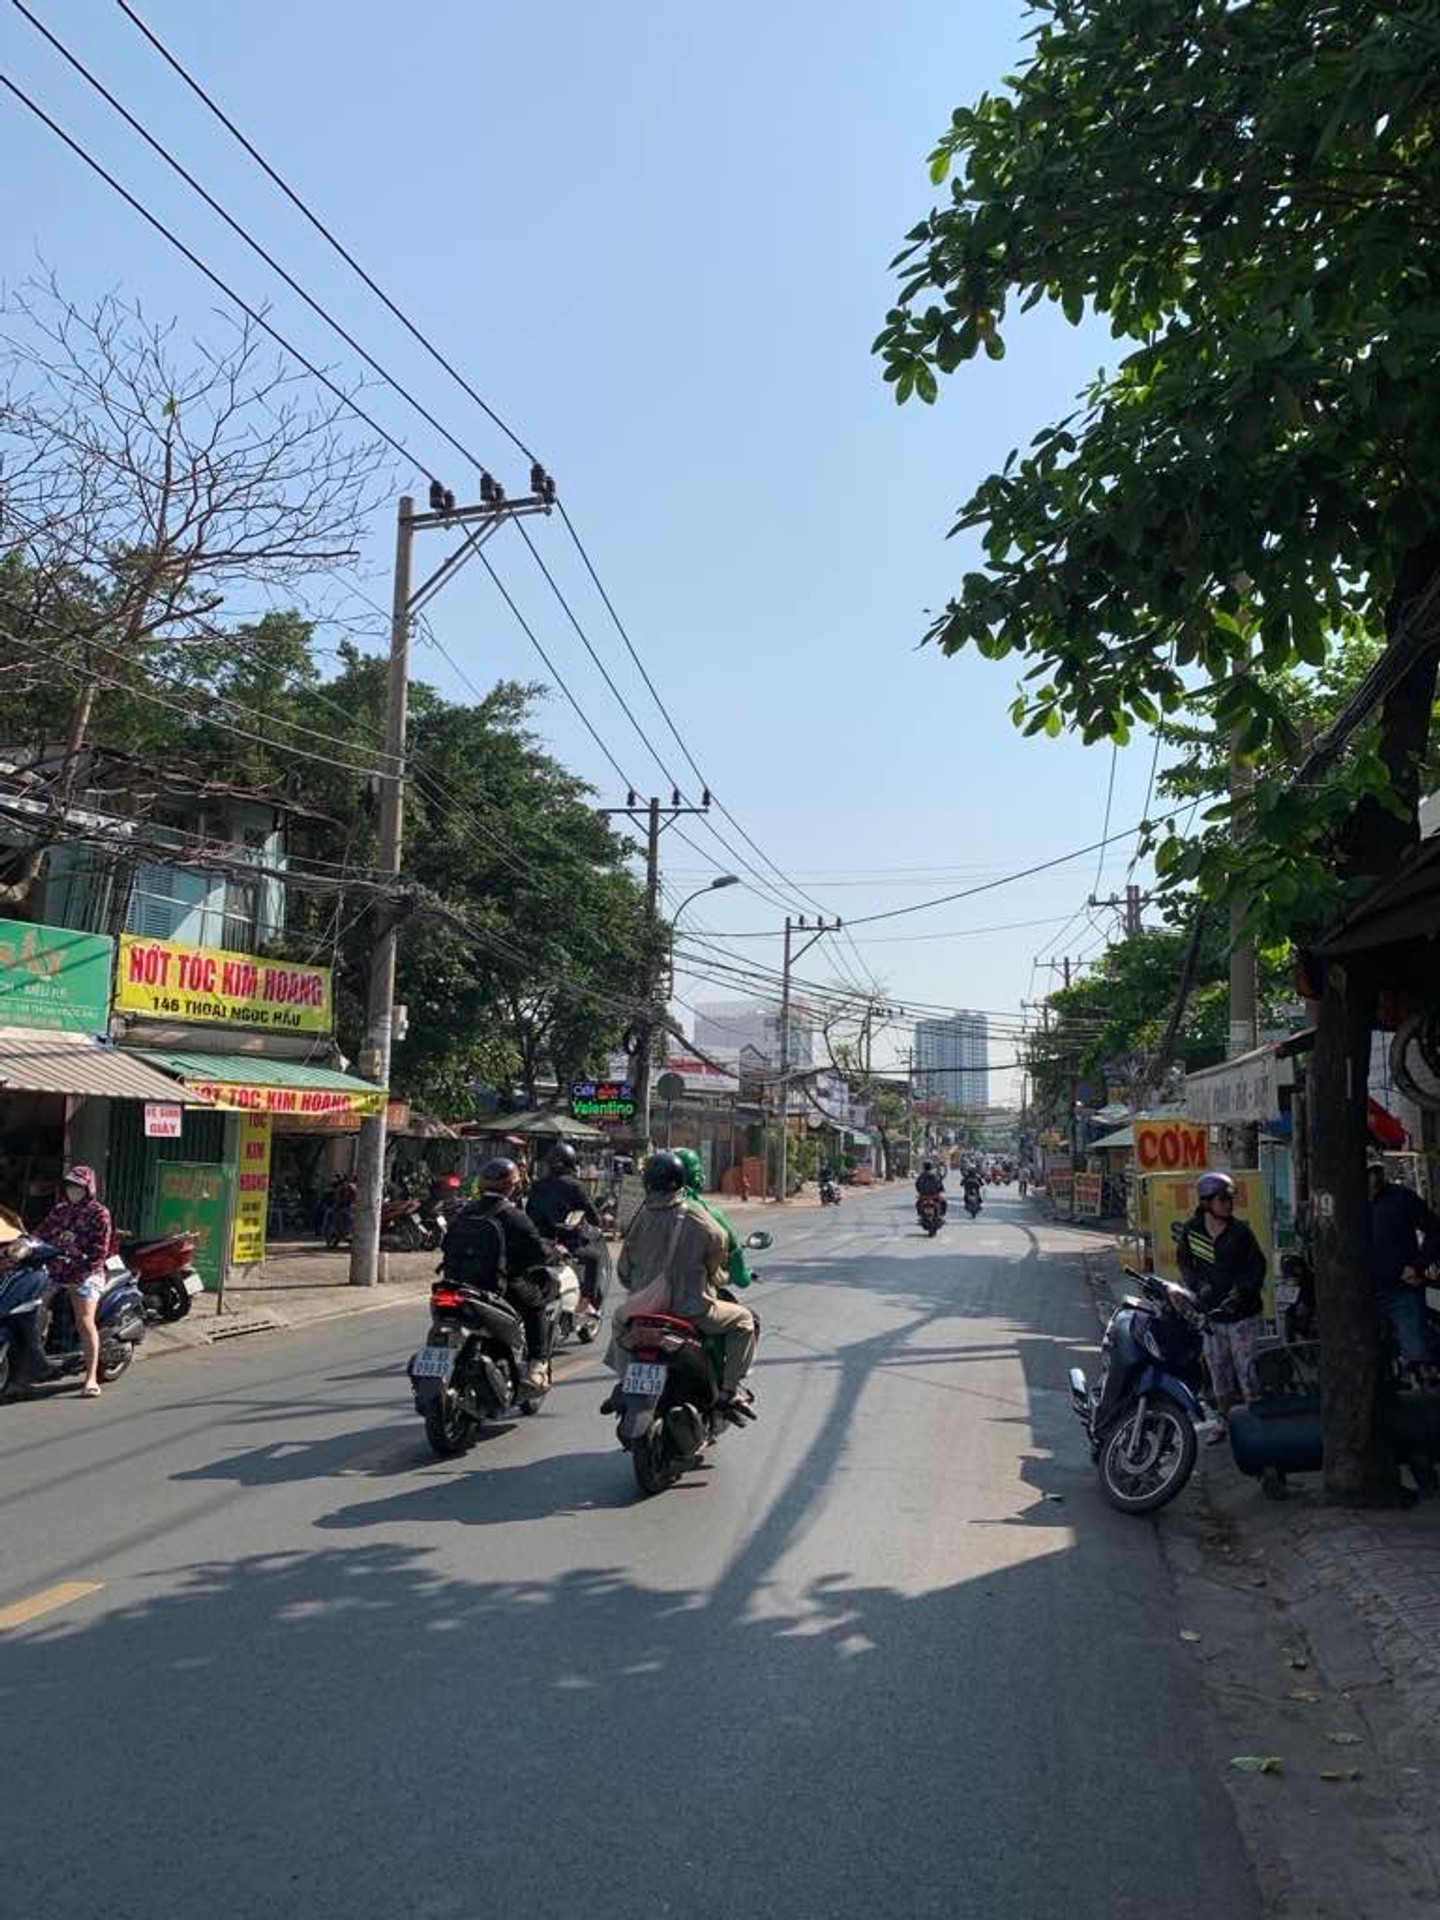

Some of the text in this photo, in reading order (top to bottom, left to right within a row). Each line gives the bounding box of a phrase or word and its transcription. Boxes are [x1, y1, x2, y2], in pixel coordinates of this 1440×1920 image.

[178, 952, 216, 993] TÓC
[222, 961, 258, 998] KIM
[152, 996, 179, 1012] 146
[266, 1089, 297, 1111] KIM
[571, 1100, 634, 1117] Valentino
[1139, 1123, 1207, 1170] CƠM
